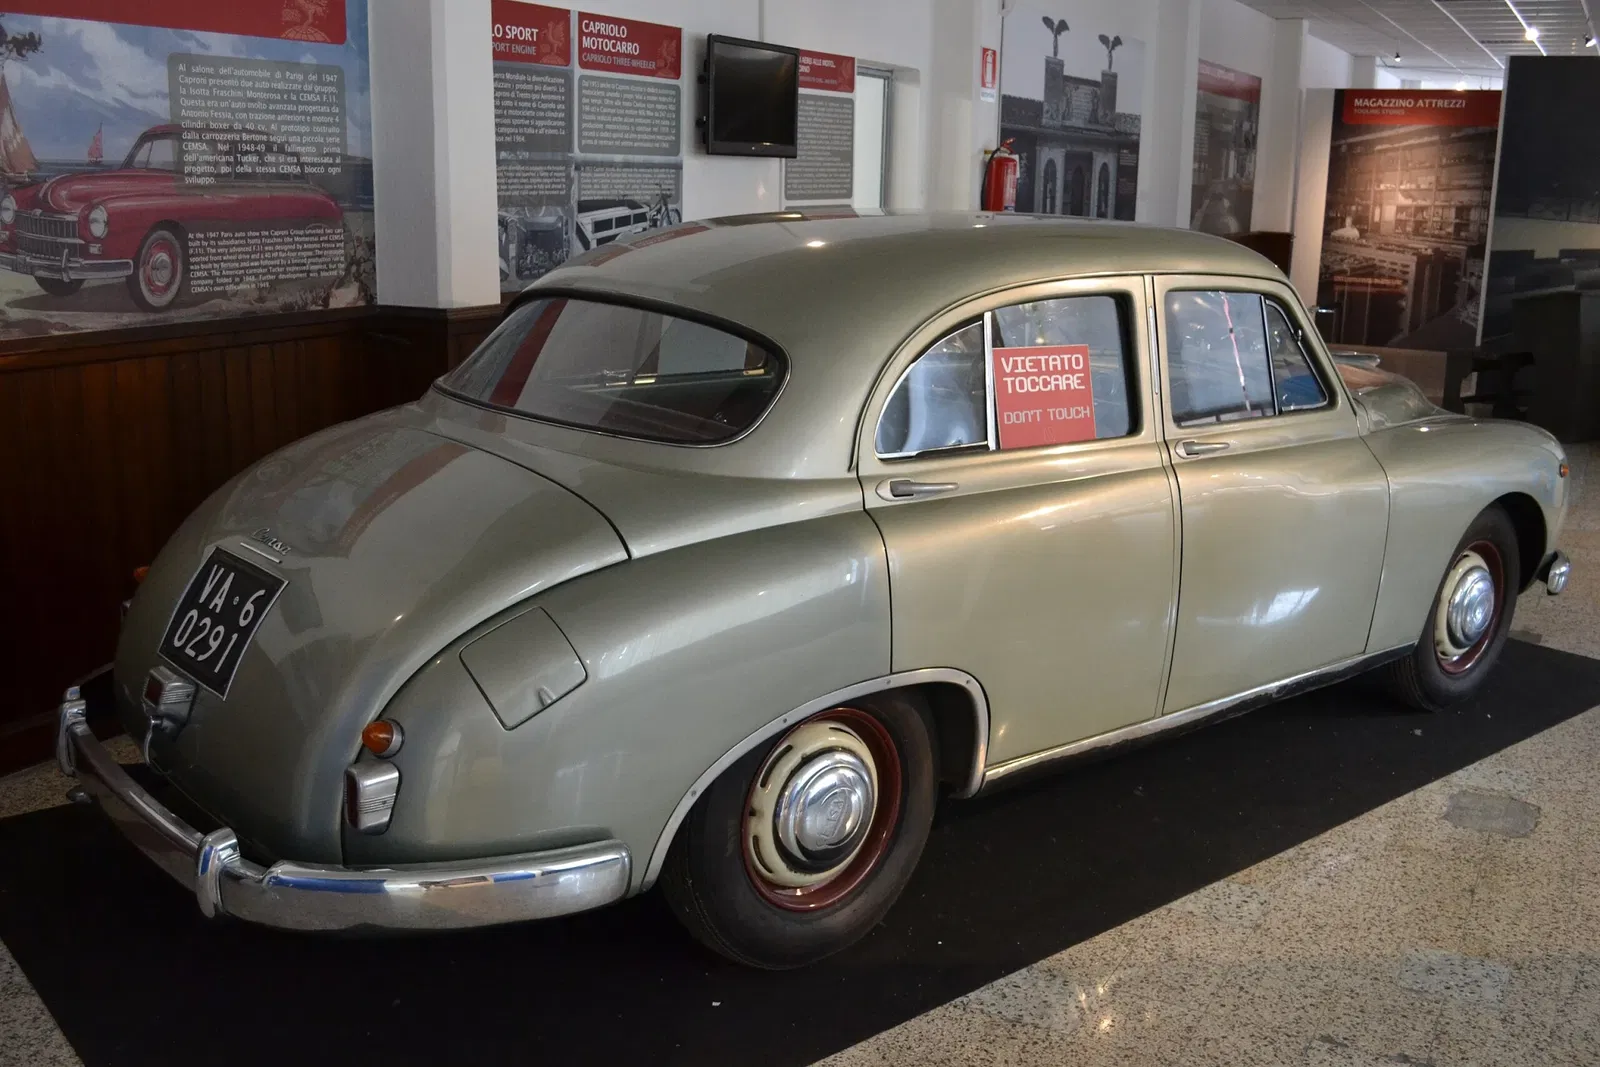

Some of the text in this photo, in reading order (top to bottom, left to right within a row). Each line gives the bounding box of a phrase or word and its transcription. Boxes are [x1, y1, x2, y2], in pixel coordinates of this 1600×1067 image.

[505, 25, 539, 42] SPORT
[582, 20, 627, 38] CAPRIOLO
[492, 42, 537, 55] PORT ENGINE
[582, 36, 640, 55] MOTOCARRO
[582, 53, 656, 69] CAPRIOLO THREE-WHEELER
[178, 63, 338, 82] Al salone dell'automobile di Parigi del 1947
[179, 74, 207, 85] Caproni
[240, 80, 254, 88] due
[255, 80, 270, 88] auto
[271, 81, 302, 90] realizzate
[303, 83, 313, 91] dal
[314, 85, 339, 93] gruppo,
[179, 85, 187, 95] la
[190, 87, 210, 96] Isotta
[213, 88, 243, 97] Fraschini
[246, 90, 281, 99] Monterosa
[290, 92, 297, 101] la
[299, 93, 321, 102] CEMSA
[180, 97, 205, 107] Questa
[247, 101, 267, 110] molto
[268, 103, 297, 111] avanzata
[298, 104, 330, 113] progettata
[331, 105, 340, 113] da
[1354, 98, 1467, 109] MAGAZZINO ATTREZZI
[180, 109, 209, 118] Antonio
[210, 110, 234, 119] Fessia,
[248, 112, 276, 121] trazione
[277, 114, 306, 122] anteriore
[312, 115, 334, 123] motore
[181, 120, 206, 129] cilindri
[210, 120, 230, 129] boxer
[233, 121, 242, 130] da
[245, 122, 255, 130] 40
[271, 123, 278, 131] Al
[280, 124, 310, 133] prototipo
[313, 125, 340, 133] costruito
[182, 131, 200, 140] dalla
[201, 132, 240, 141] carrozzeria
[242, 133, 268, 142] Bertone
[302, 135, 325, 144] piccola
[217, 143, 229, 151] Nel
[238, 143, 266, 152] 1948-49
[272, 144, 278, 152] il
[284, 144, 317, 153] fallimento
[323, 146, 341, 154] prima
[183, 153, 234, 162] dell'americana
[236, 153, 262, 163] Tucker,
[264, 154, 276, 163] che
[278, 155, 285, 163] si
[300, 155, 334, 164] interessata
[335, 156, 342, 164] al
[184, 165, 217, 174] progetto,
[220, 165, 233, 175] poi
[235, 164, 253, 173] della
[279, 165, 301, 173] CEMSA
[327, 166, 342, 175] ogni
[185, 175, 217, 185] sviluppo.
[217, 238, 246, 246] subsidiaries
[189, 255, 209, 263] sported
[1001, 354, 1084, 374] VIETATO
[1003, 373, 1086, 394] TOCCARE
[1004, 406, 1090, 425] DON'T TOUCH
[173, 609, 239, 673] 0291
